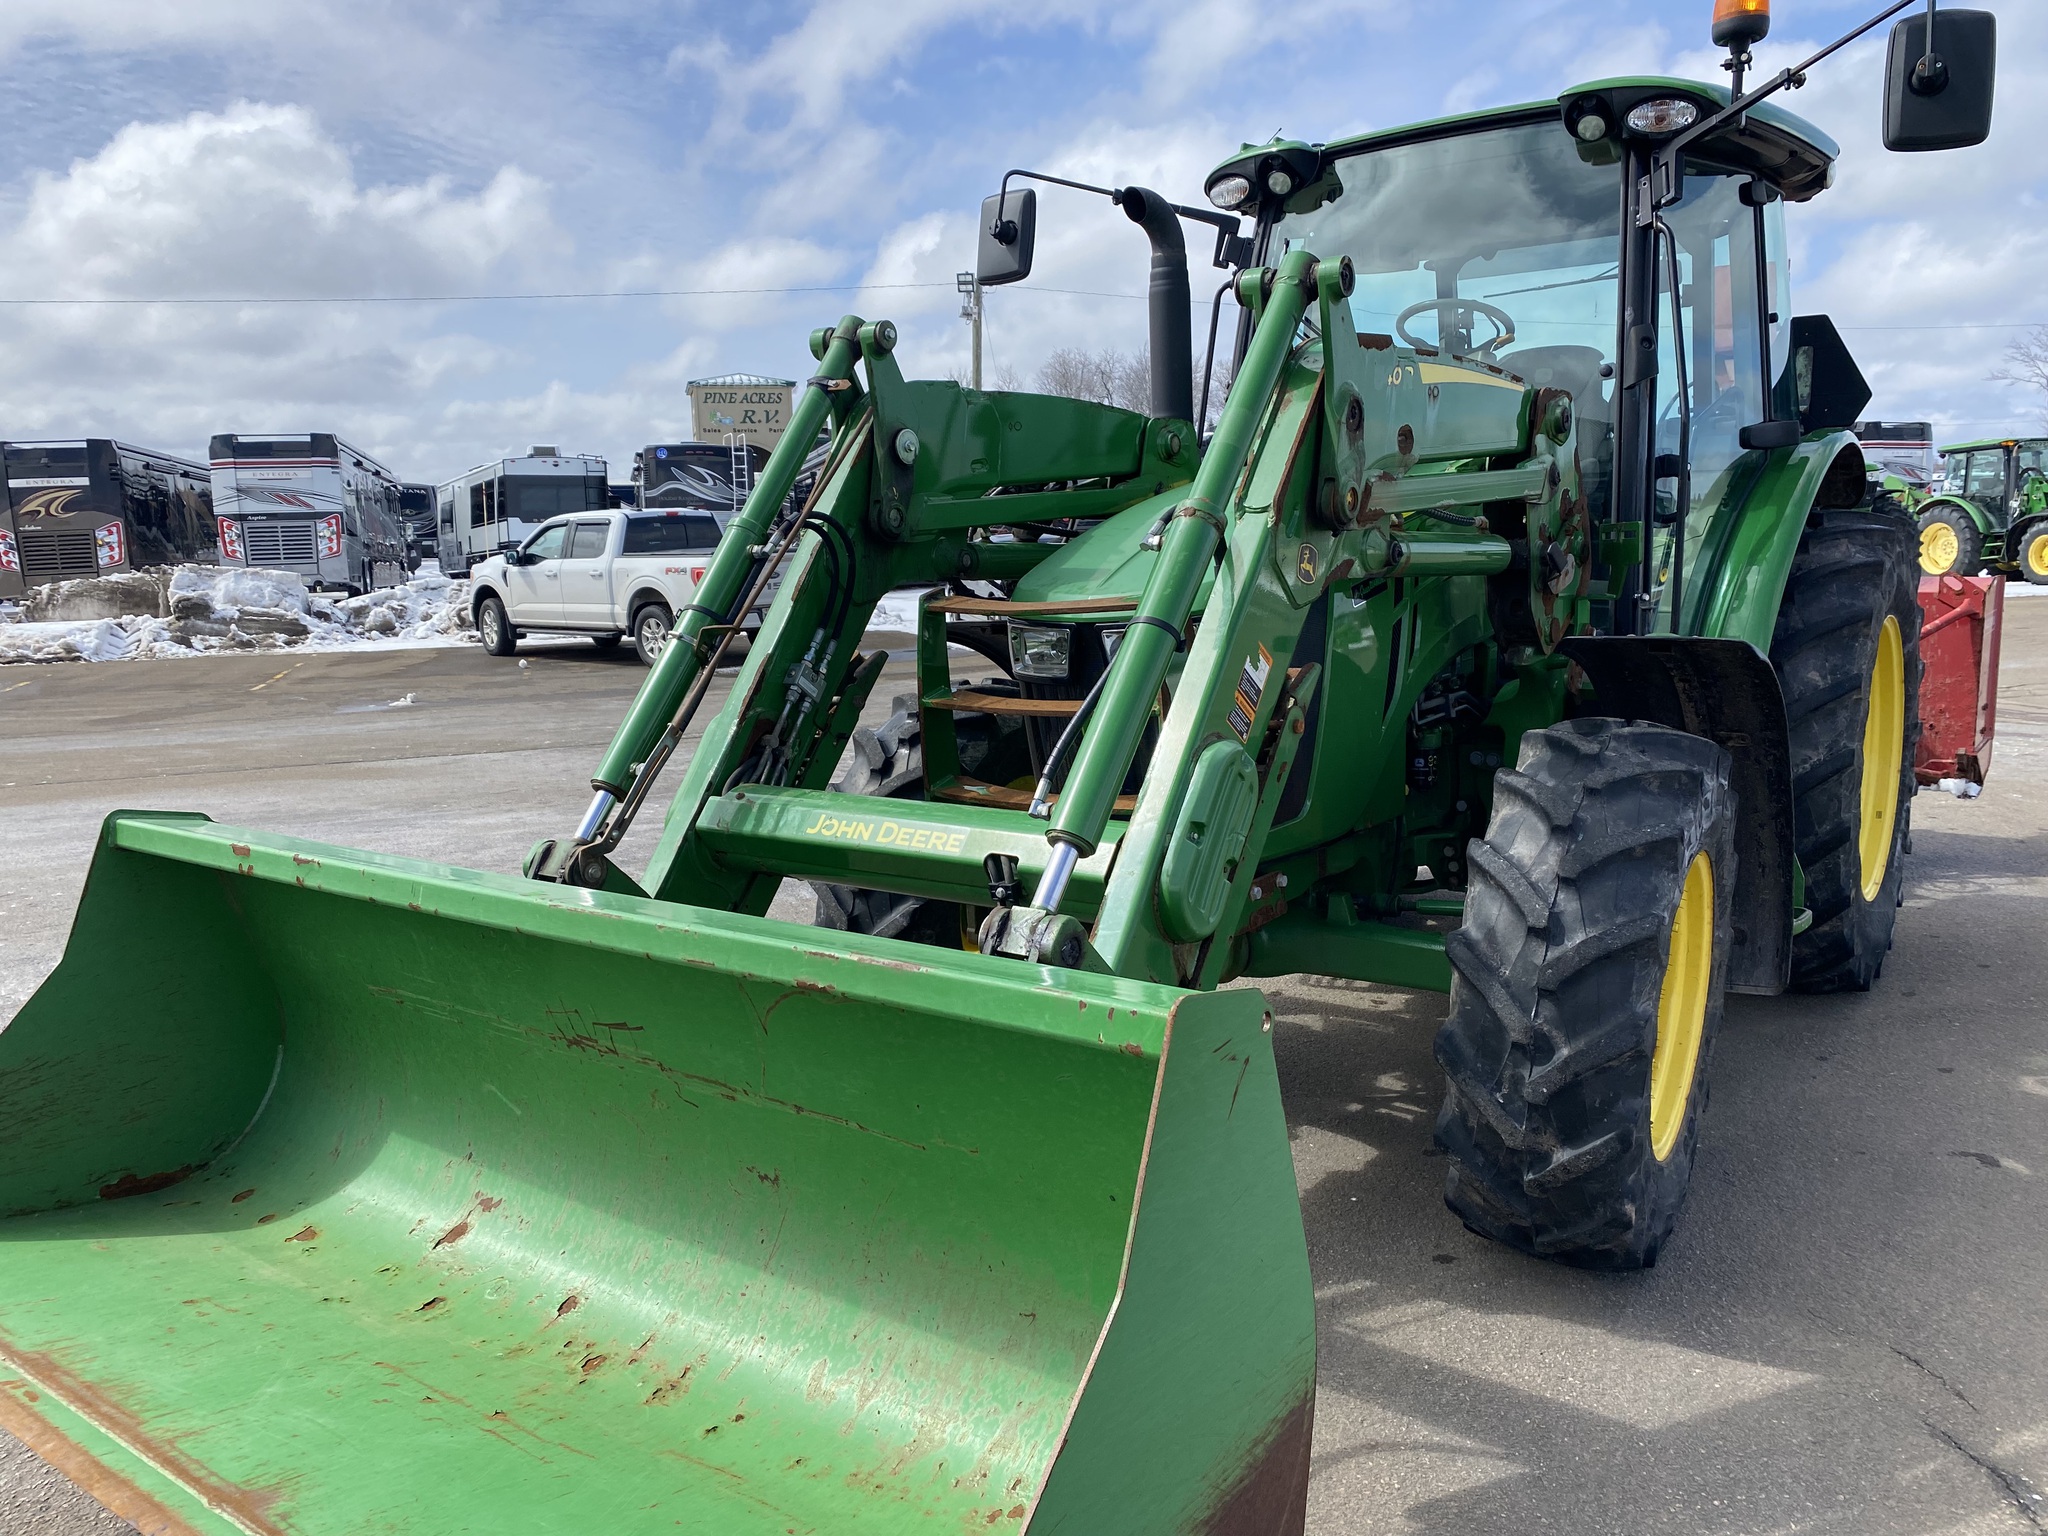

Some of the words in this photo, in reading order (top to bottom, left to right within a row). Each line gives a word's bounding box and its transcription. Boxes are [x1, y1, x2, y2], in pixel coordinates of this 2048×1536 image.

[703, 392, 738, 404] PINE
[739, 392, 783, 404] ACRES
[740, 409, 779, 424] R.V.
[665, 567, 687, 575] FX4
[806, 814, 874, 841] JOHN
[876, 822, 966, 853] DEERE
